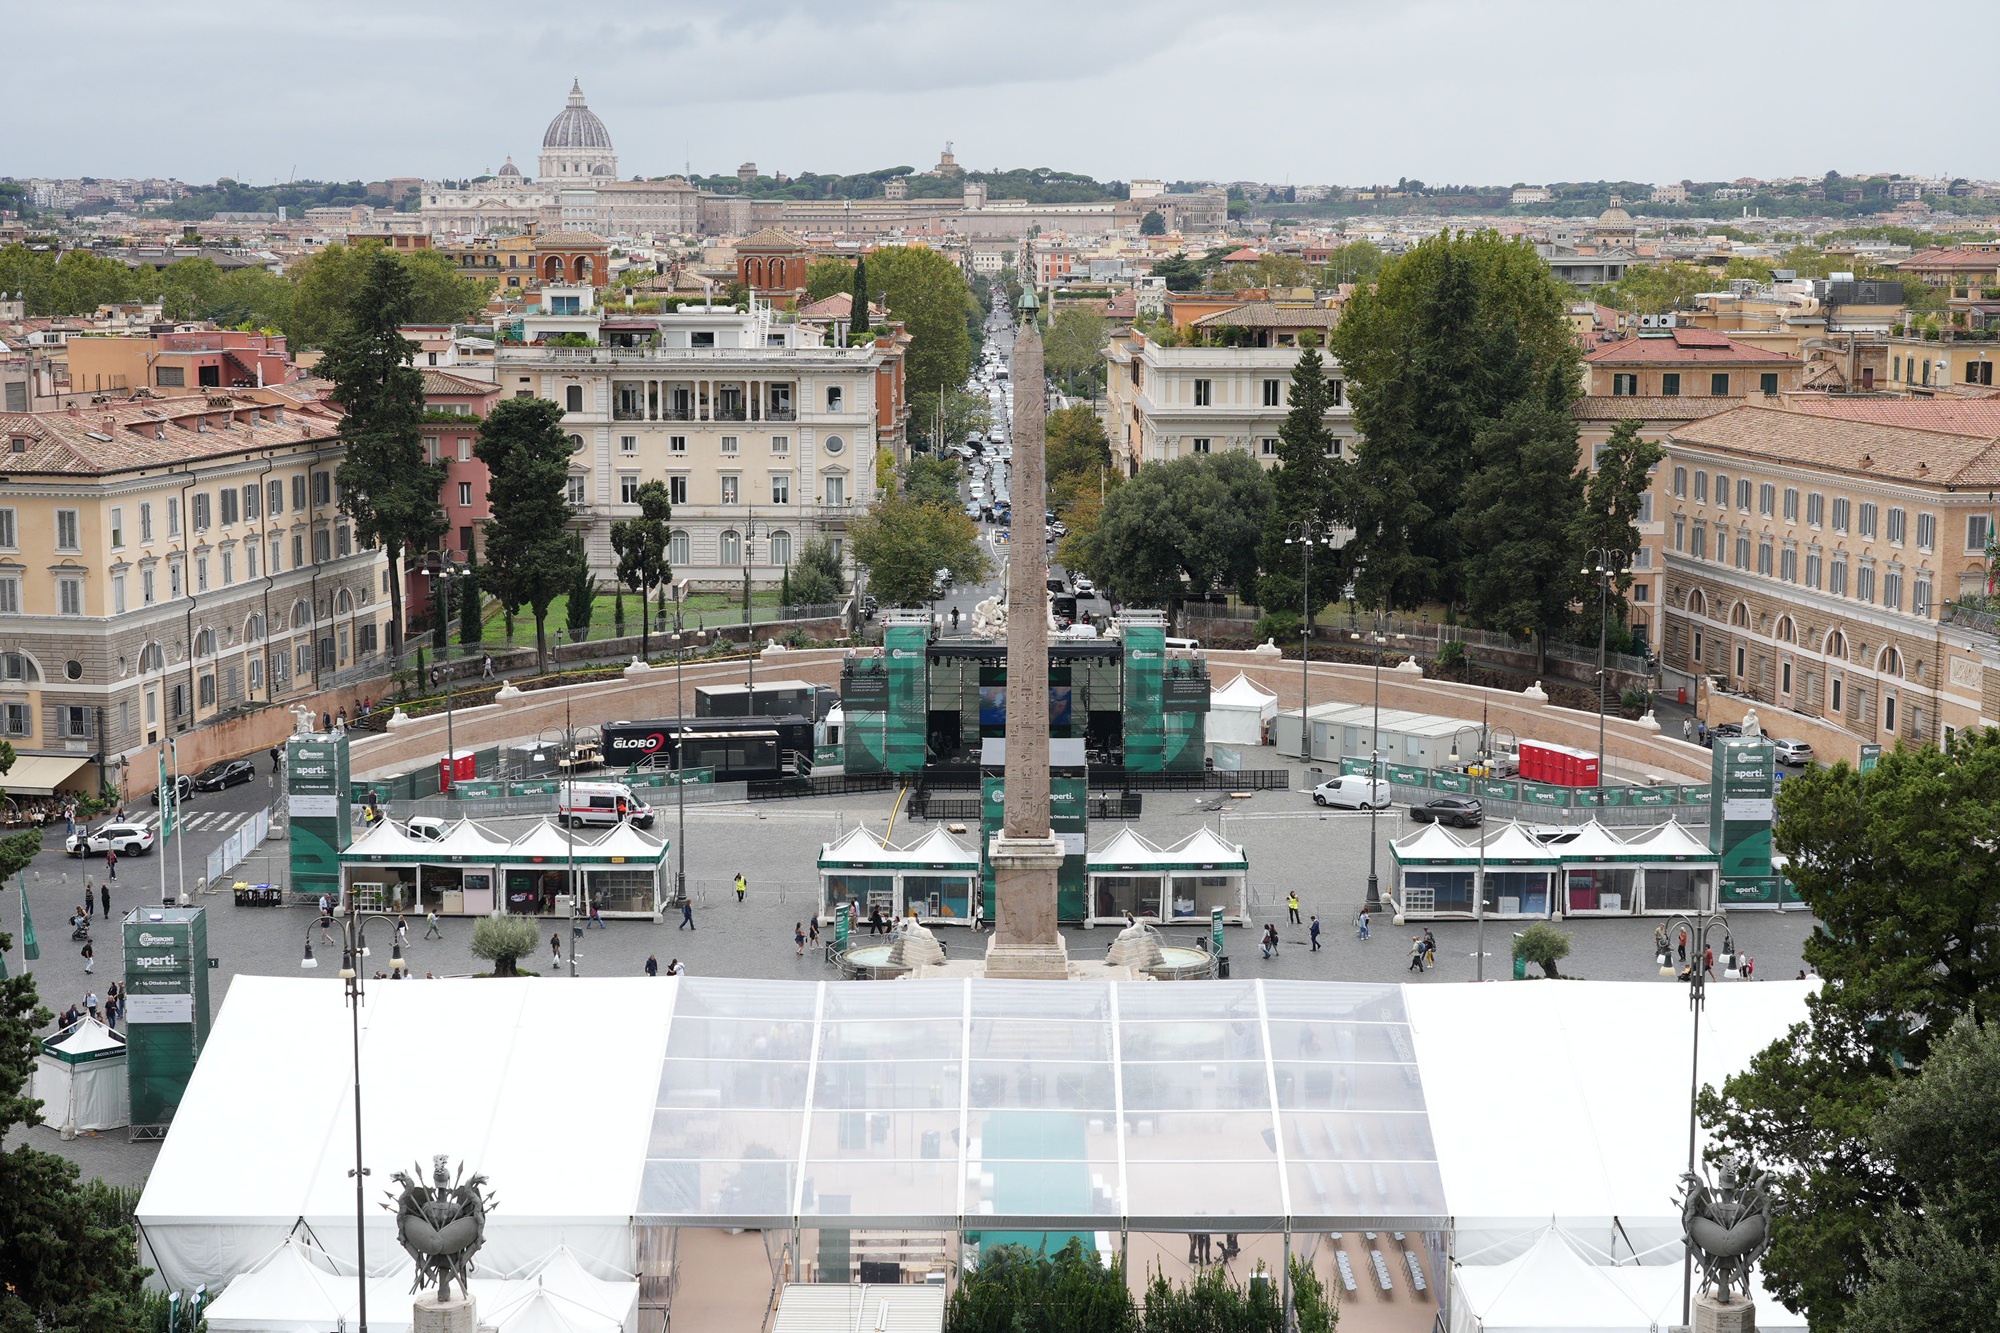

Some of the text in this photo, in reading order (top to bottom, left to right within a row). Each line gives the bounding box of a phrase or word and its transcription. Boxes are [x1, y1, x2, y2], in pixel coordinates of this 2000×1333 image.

[613, 738, 656, 748] GLOBO
[296, 766, 326, 775] aperti.
[1734, 769, 1764, 779] aperti.
[1049, 792, 1074, 801] aperti.
[137, 954, 178, 968] aperti.
